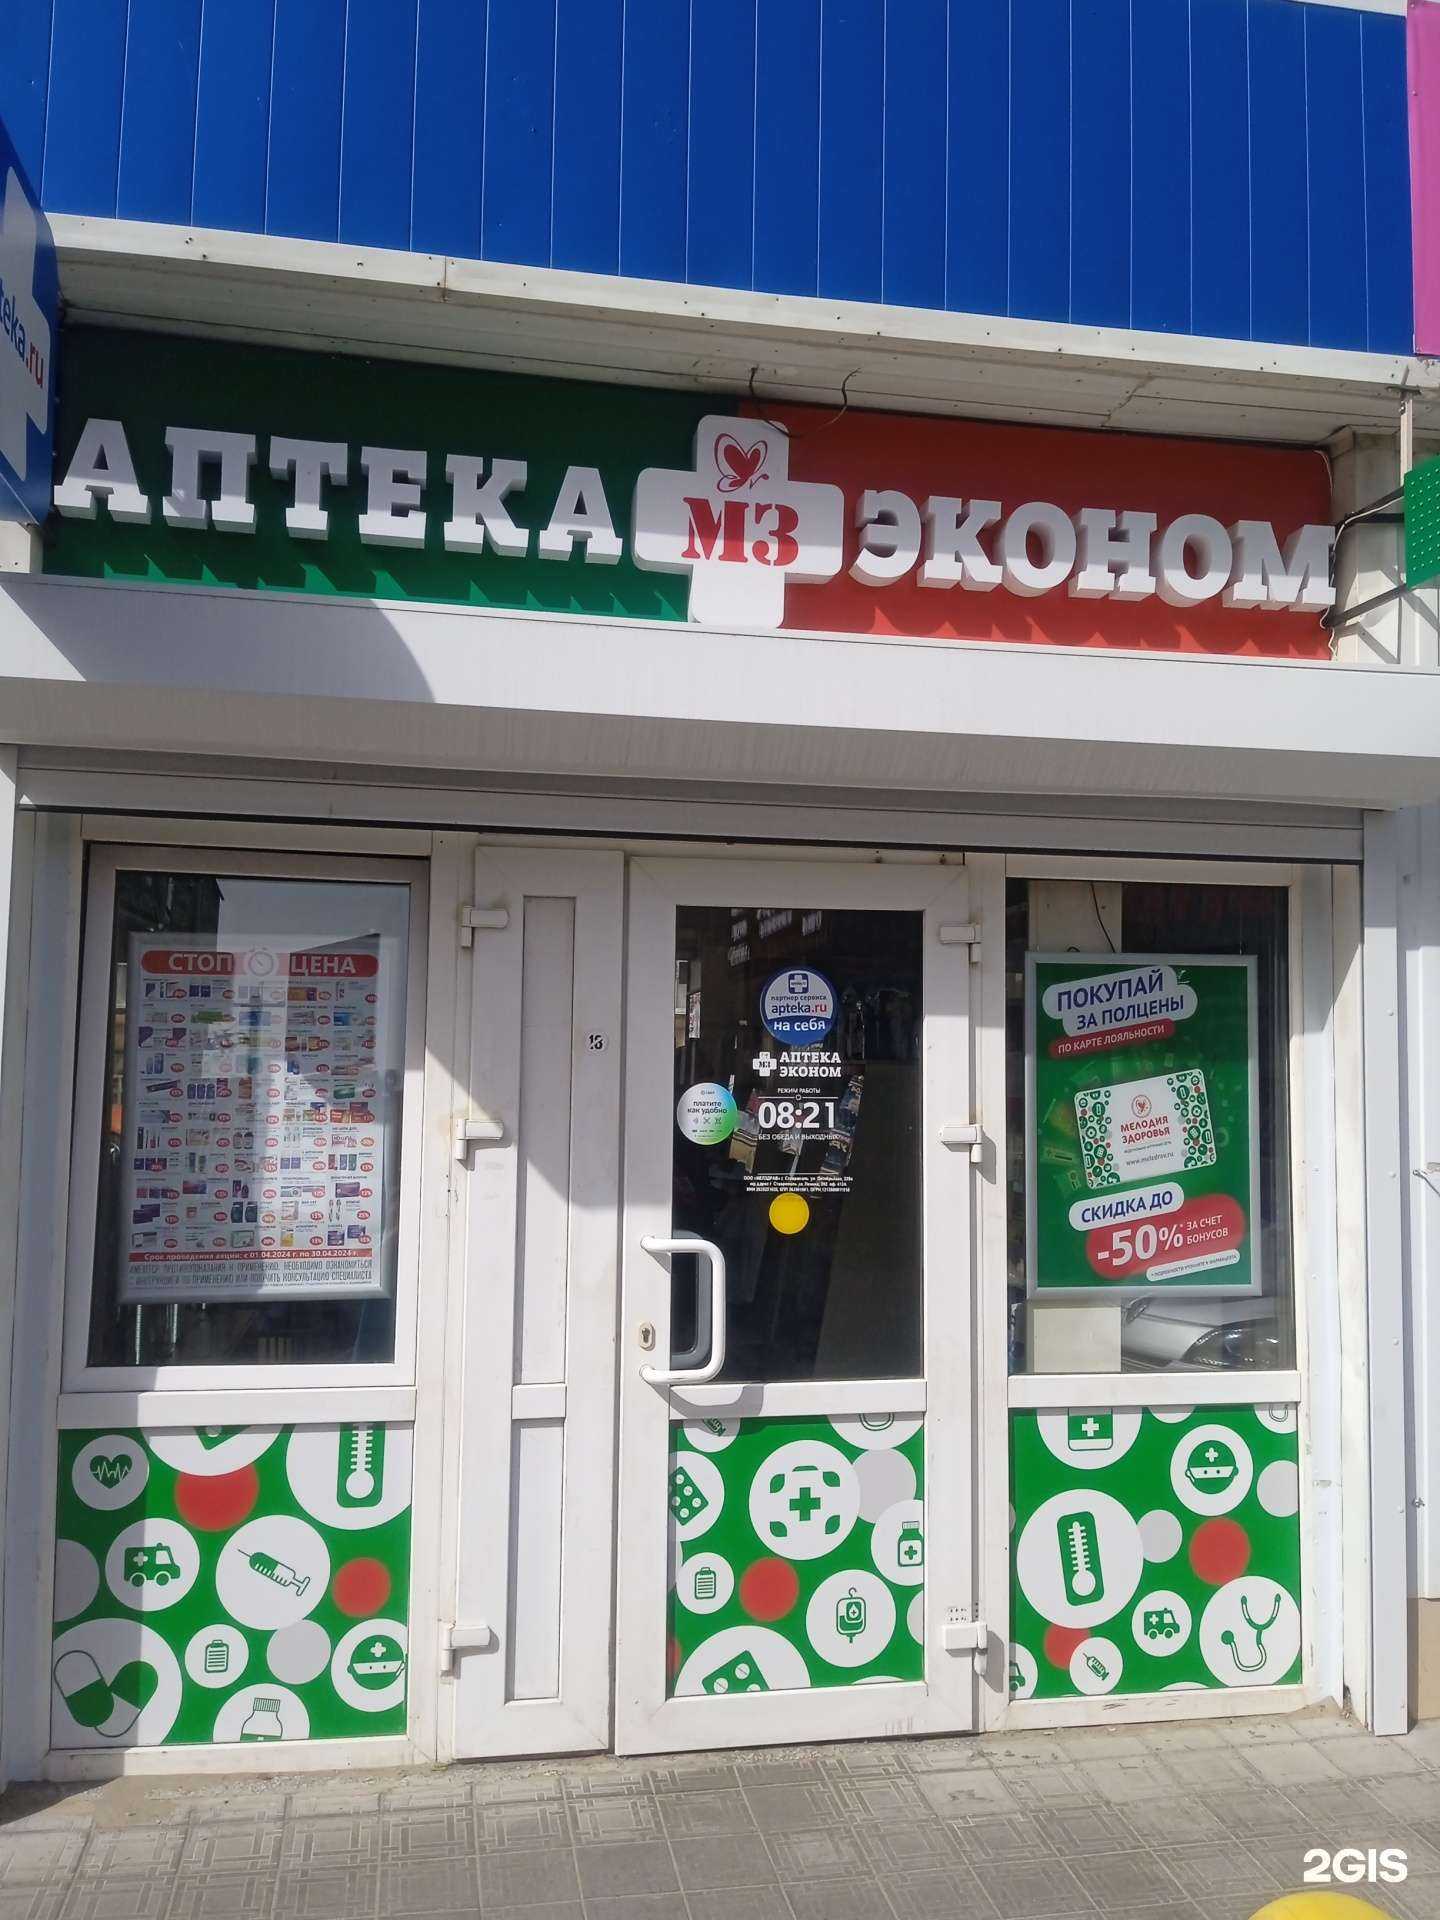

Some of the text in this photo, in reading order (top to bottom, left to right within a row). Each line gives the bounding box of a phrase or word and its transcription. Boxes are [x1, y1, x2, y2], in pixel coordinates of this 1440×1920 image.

[54, 418, 623, 565] АПТЕКА
[681, 496, 800, 567] МЗ
[849, 489, 1336, 613] ЭКОНОМ
[168, 953, 357, 978] СТОП ЦЕНА
[1057, 968, 1164, 1012] ПОКУПАЙ
[771, 1002, 827, 1016] apteka.ru
[1077, 995, 1184, 1030] ЗА ПОЛЦЕНЫ
[773, 1017, 826, 1031] на себя
[1058, 1024, 1165, 1054] ПО КАРТЕ ЛОЯЛЬНОСТИ
[779, 1051, 842, 1064] АПТЕКА
[779, 1066, 842, 1078] ЭКОНОМ
[701, 1106, 728, 1115] удобно
[758, 1101, 835, 1129] 08:21
[1120, 1115, 1169, 1133] МЕЛОДИЯ
[1121, 1126, 1171, 1145] ЗДОРОВЬЯ
[1081, 1190, 1173, 1223] СКИДКА ДО
[1186, 1214, 1223, 1231] ЗА СЧЕТ
[1186, 1227, 1229, 1245] БОНУСОВ
